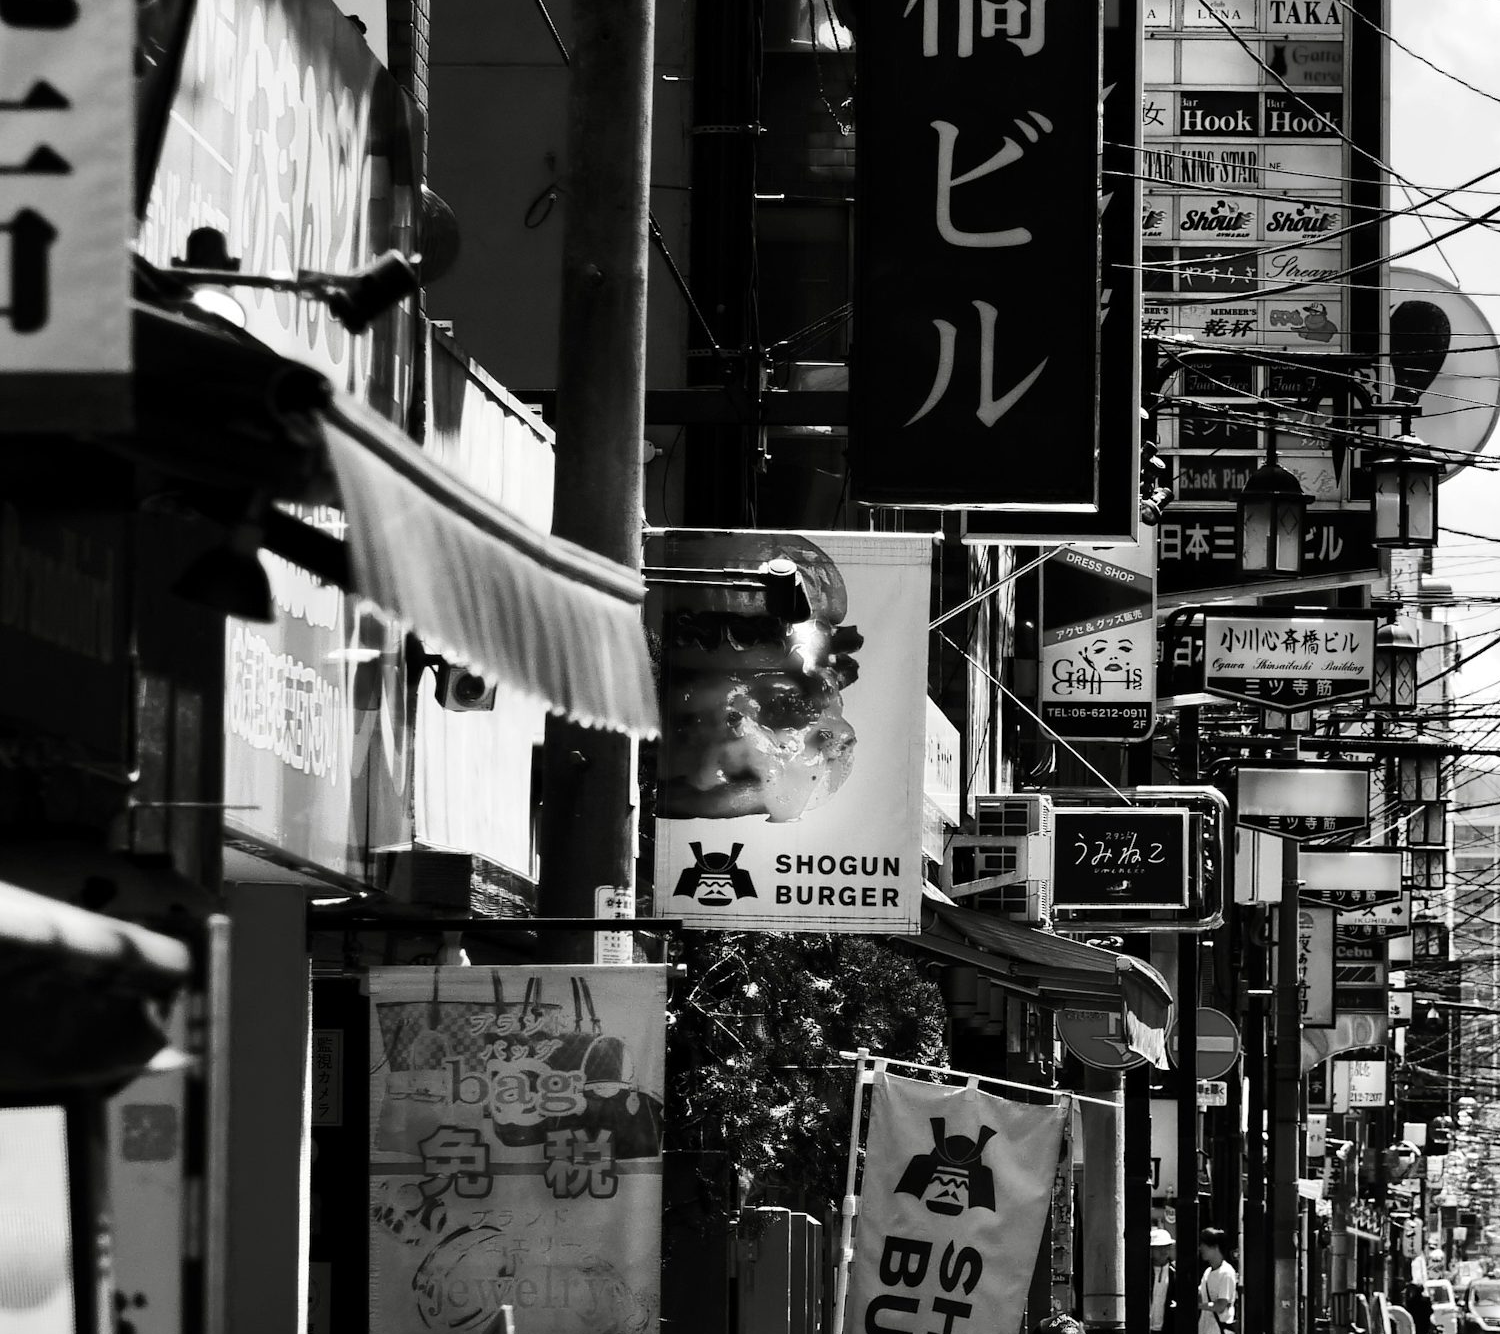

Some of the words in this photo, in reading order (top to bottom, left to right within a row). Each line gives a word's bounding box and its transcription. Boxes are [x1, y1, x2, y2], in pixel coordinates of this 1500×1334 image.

[1197, 8, 1241, 20] LUNA
[1269, 0, 1342, 25] TAKA
[1267, 98, 1287, 109] Bar
[1182, 109, 1253, 133] Hook
[1271, 111, 1340, 133] Hook
[1180, 212, 1243, 232] Shout
[1267, 212, 1330, 234] Shout
[1265, 254, 1339, 278] Stream
[1210, 308, 1257, 316] MEMBER'S
[1202, 318, 1257, 338] 乾杯
[1180, 467, 1217, 490] Black
[1066, 552, 1103, 572] DRESS
[1104, 565, 1135, 584] SHOP
[1220, 627, 1360, 655] 小川心斎橋ビル
[1212, 657, 1245, 671] Ogawa
[1253, 658, 1312, 672] Shinsaibashi
[1321, 661, 1365, 675] Building
[1245, 678, 1333, 697] 三ツ寺筋
[1047, 707, 1147, 718] TEL:06-6212-0911
[1133, 720, 1148, 730] 2F
[1269, 816, 1338, 832] 三ツ寺筋
[1074, 832, 1165, 865] うみねこ
[774, 853, 901, 877] SHOGUN
[774, 885, 901, 908] BURGER
[1321, 891, 1376, 901] 三ツ寺筋
[1336, 946, 1374, 958] Cebu
[315, 1033, 333, 1119] 監視カメラ
[445, 1055, 586, 1118] bag
[418, 1123, 618, 1200] 免税
[427, 1264, 614, 1318] jewelry
